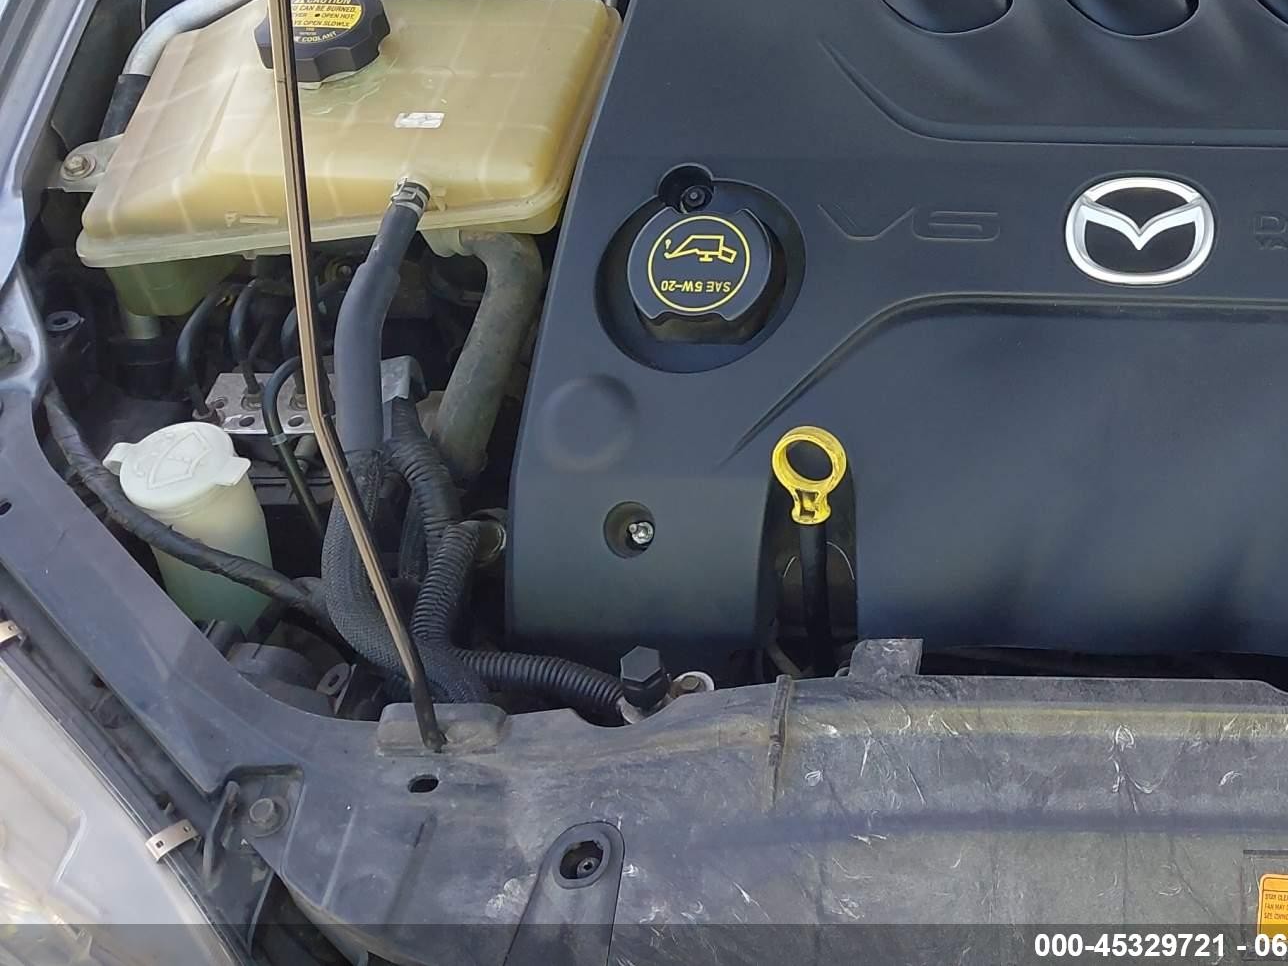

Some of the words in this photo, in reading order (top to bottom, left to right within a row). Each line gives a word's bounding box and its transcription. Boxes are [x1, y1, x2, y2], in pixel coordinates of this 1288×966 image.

[302, 31, 337, 43] COOLANT
[817, 203, 1001, 242] V6
[661, 280, 703, 293] 5W-20
[706, 281, 732, 293] SAE
